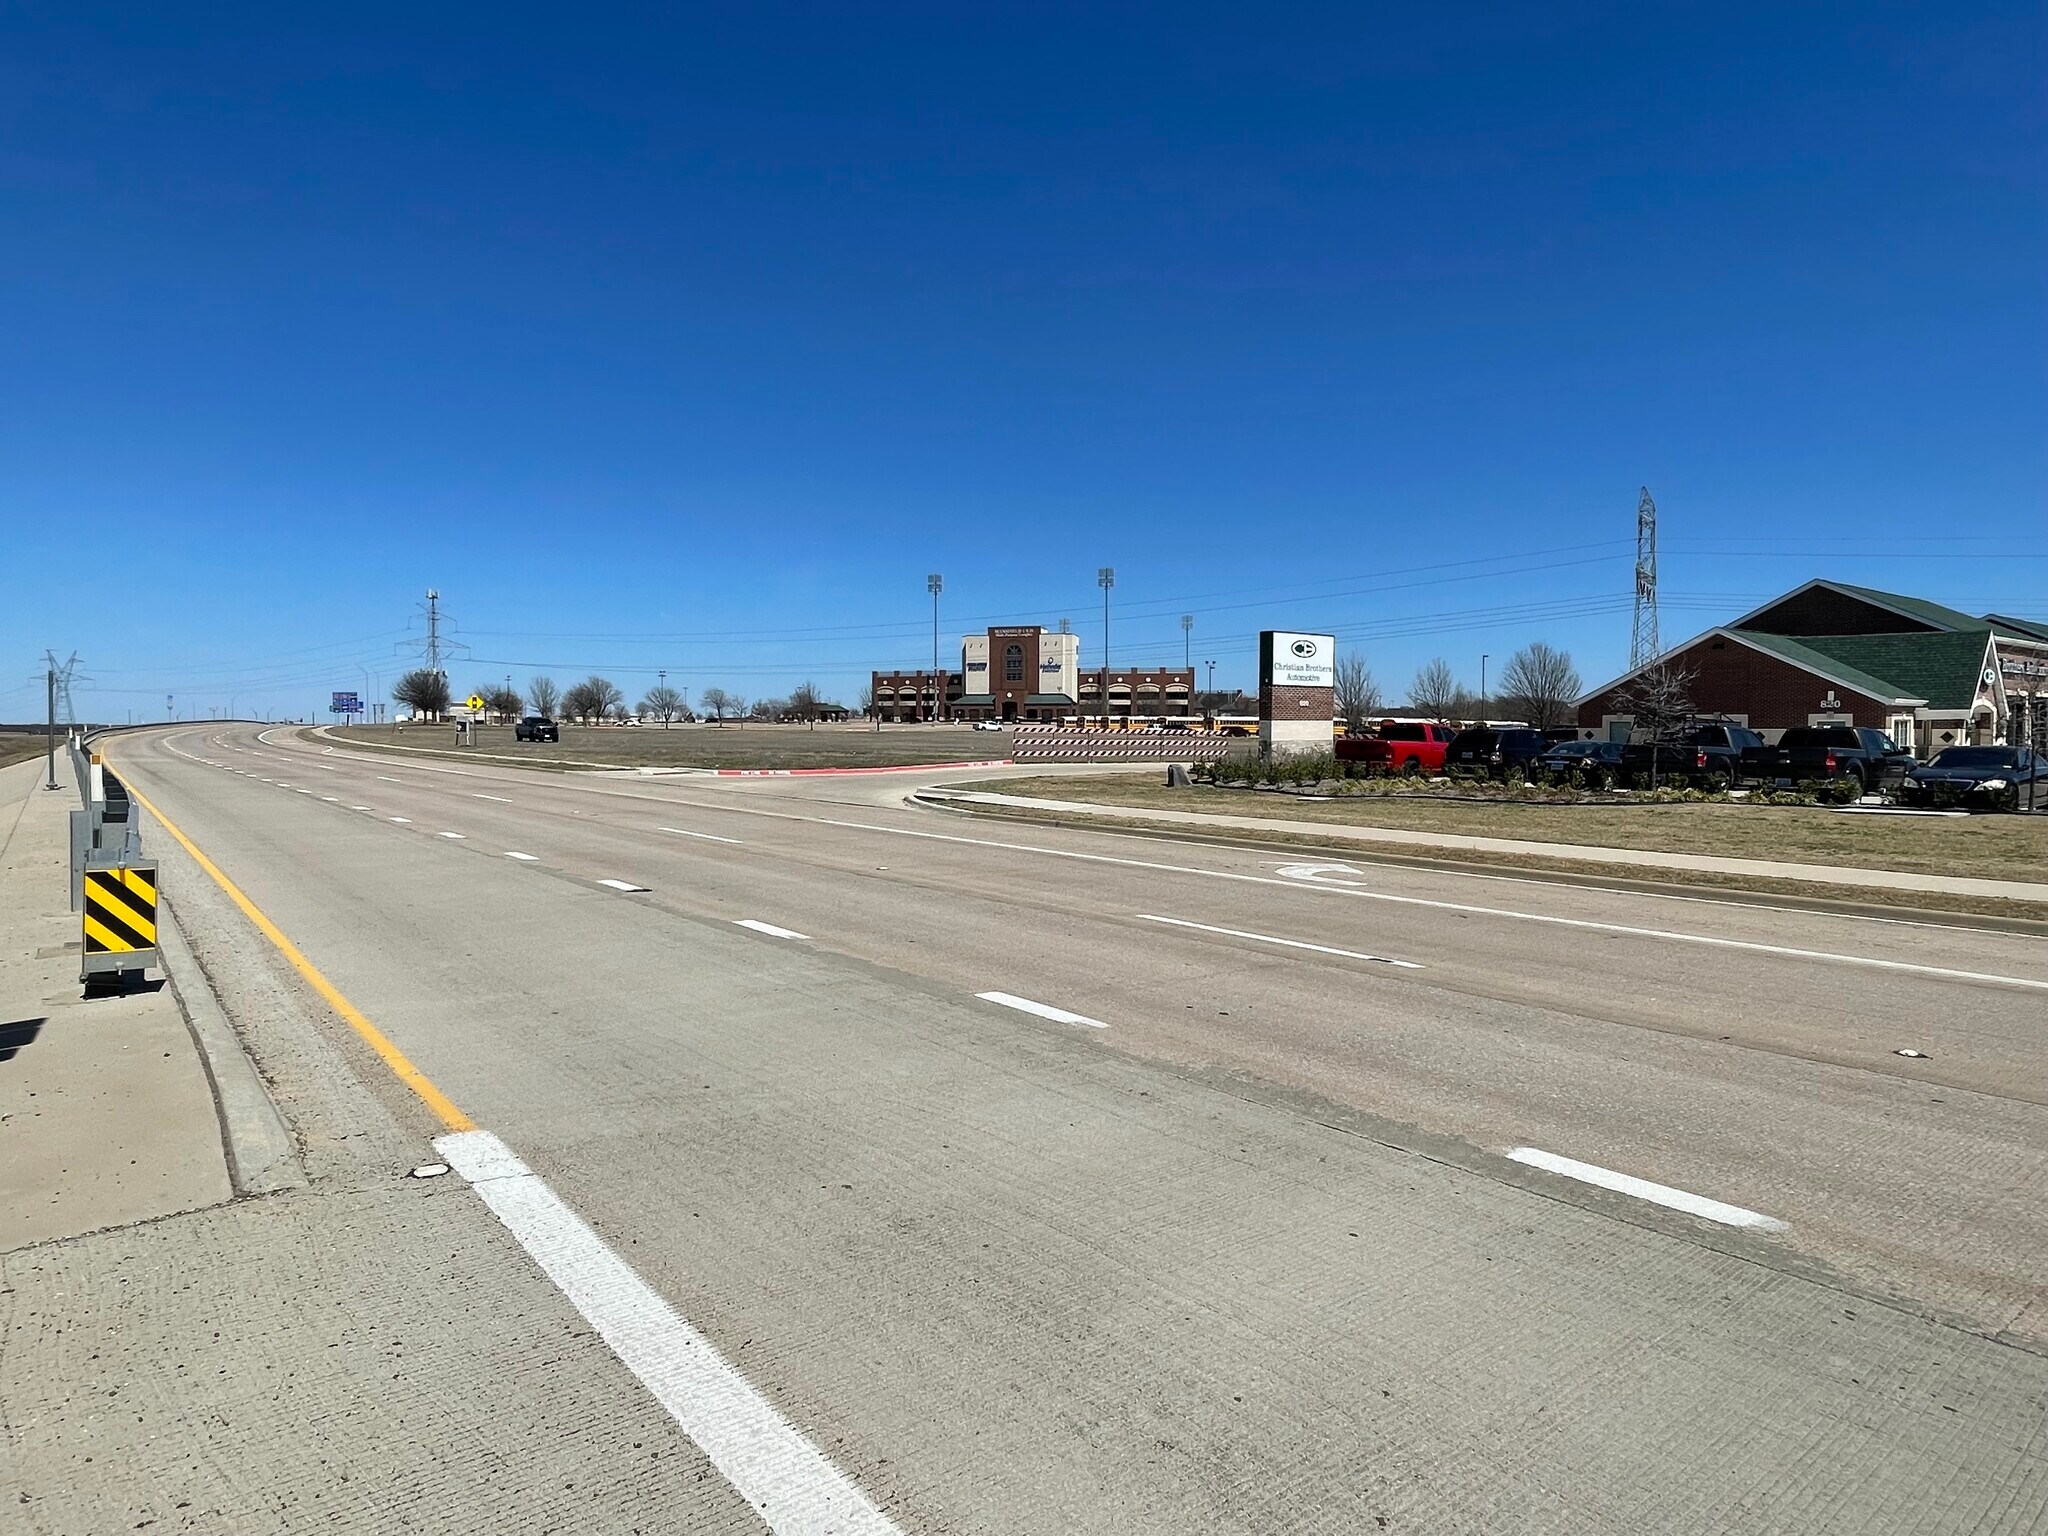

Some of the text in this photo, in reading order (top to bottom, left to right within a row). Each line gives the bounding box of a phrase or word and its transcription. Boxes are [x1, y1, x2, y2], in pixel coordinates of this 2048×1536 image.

[1274, 662, 1332, 672] Christian Brothers
[1287, 673, 1320, 682] Automotive
[1820, 700, 1840, 708] 820
